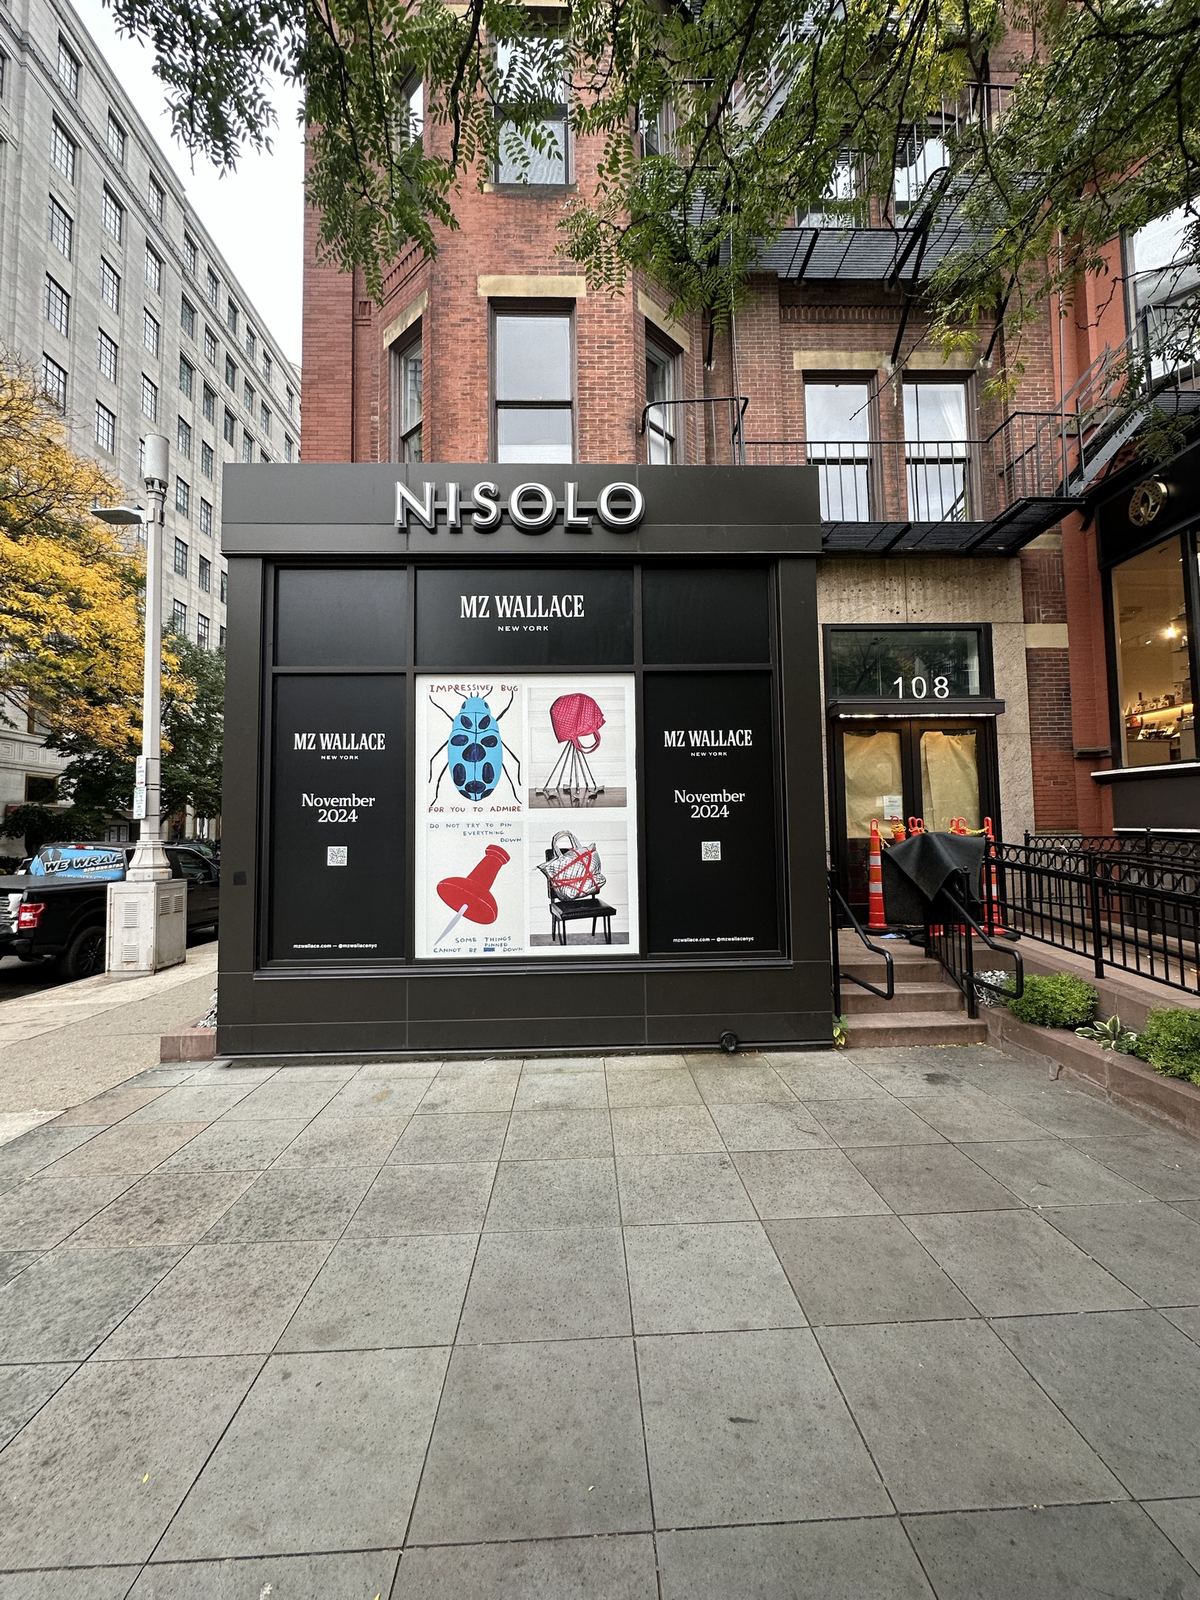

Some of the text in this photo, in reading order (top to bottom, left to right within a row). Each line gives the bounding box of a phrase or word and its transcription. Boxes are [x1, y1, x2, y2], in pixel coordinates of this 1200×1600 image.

[394, 481, 645, 530] NISOLO
[460, 594, 585, 618] MZ WALLACE
[429, 684, 519, 693] IMPRESSIVE BUG
[893, 676, 950, 699] 108
[293, 732, 386, 750] MZ WALLACE
[664, 729, 753, 747] MZ WALLACE
[301, 793, 376, 807] November
[674, 789, 746, 803] November
[317, 809, 359, 823] 2024
[690, 804, 730, 818] 2024
[44, 860, 71, 874] WE
